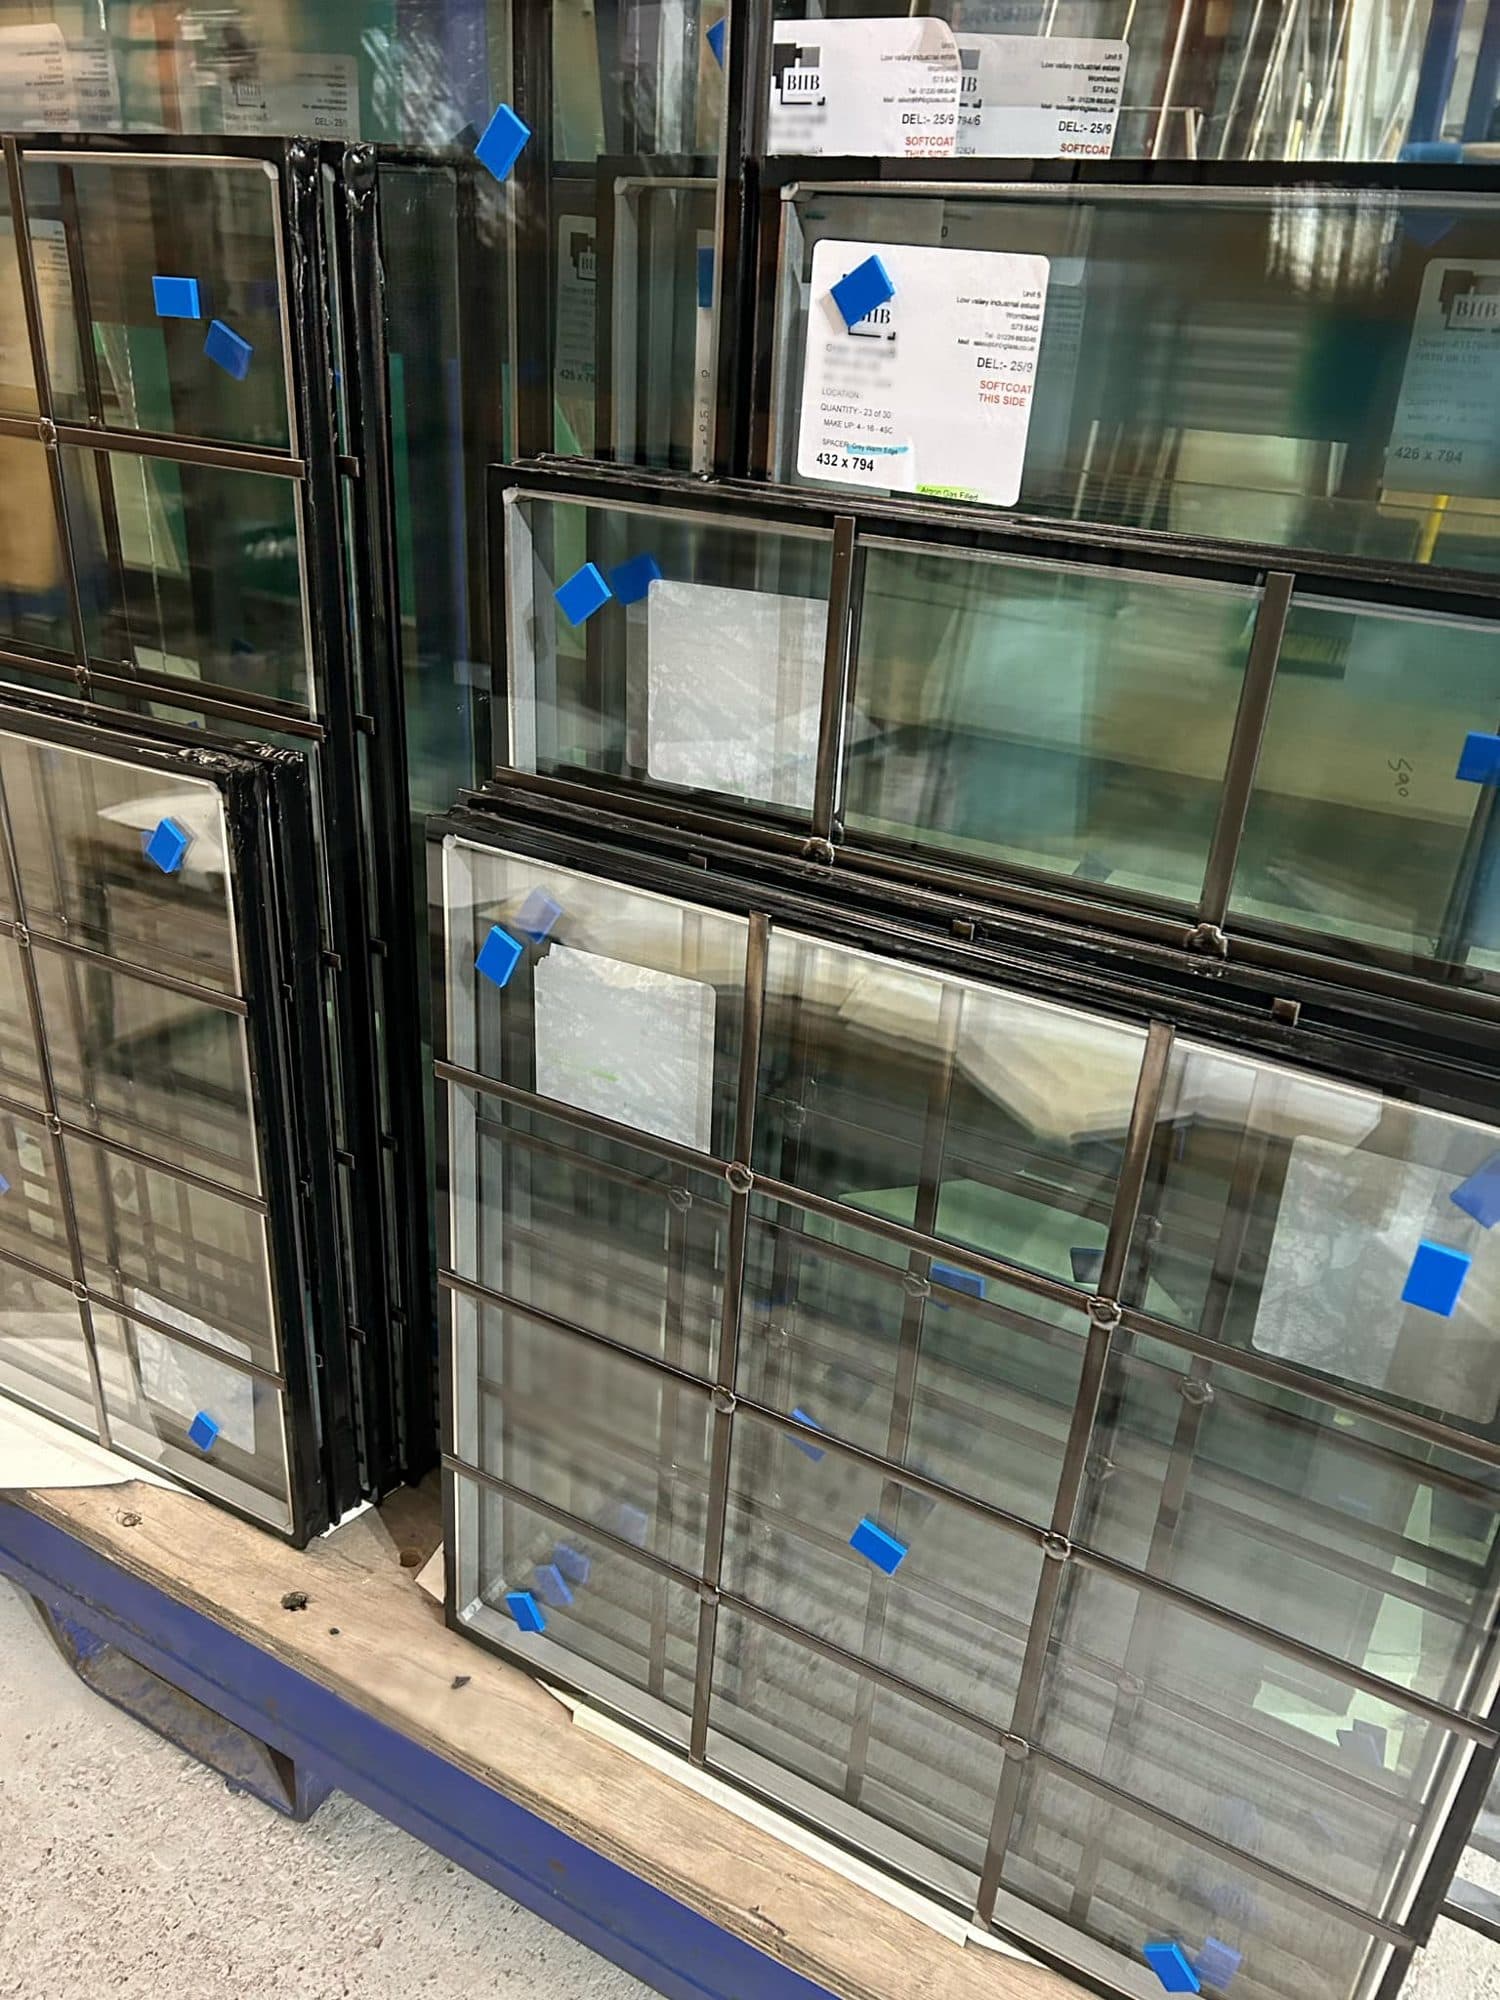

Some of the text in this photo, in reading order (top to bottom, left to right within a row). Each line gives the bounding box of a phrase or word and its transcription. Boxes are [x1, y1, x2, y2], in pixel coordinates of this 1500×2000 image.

[933, 113, 955, 125] 25/9
[1090, 123, 1112, 135] 25/9
[905, 136, 955, 147] SOFTCOAT
[1060, 143, 1110, 156] SOFTCOAT
[1010, 360, 1033, 373] 25/9
[979, 379, 1033, 395] SOFTCOAT
[978, 392, 1027, 407] THIS SIDE
[873, 409, 881, 418] of
[823, 418, 842, 429] MAKE
[816, 452, 874, 472] 432 x 794
